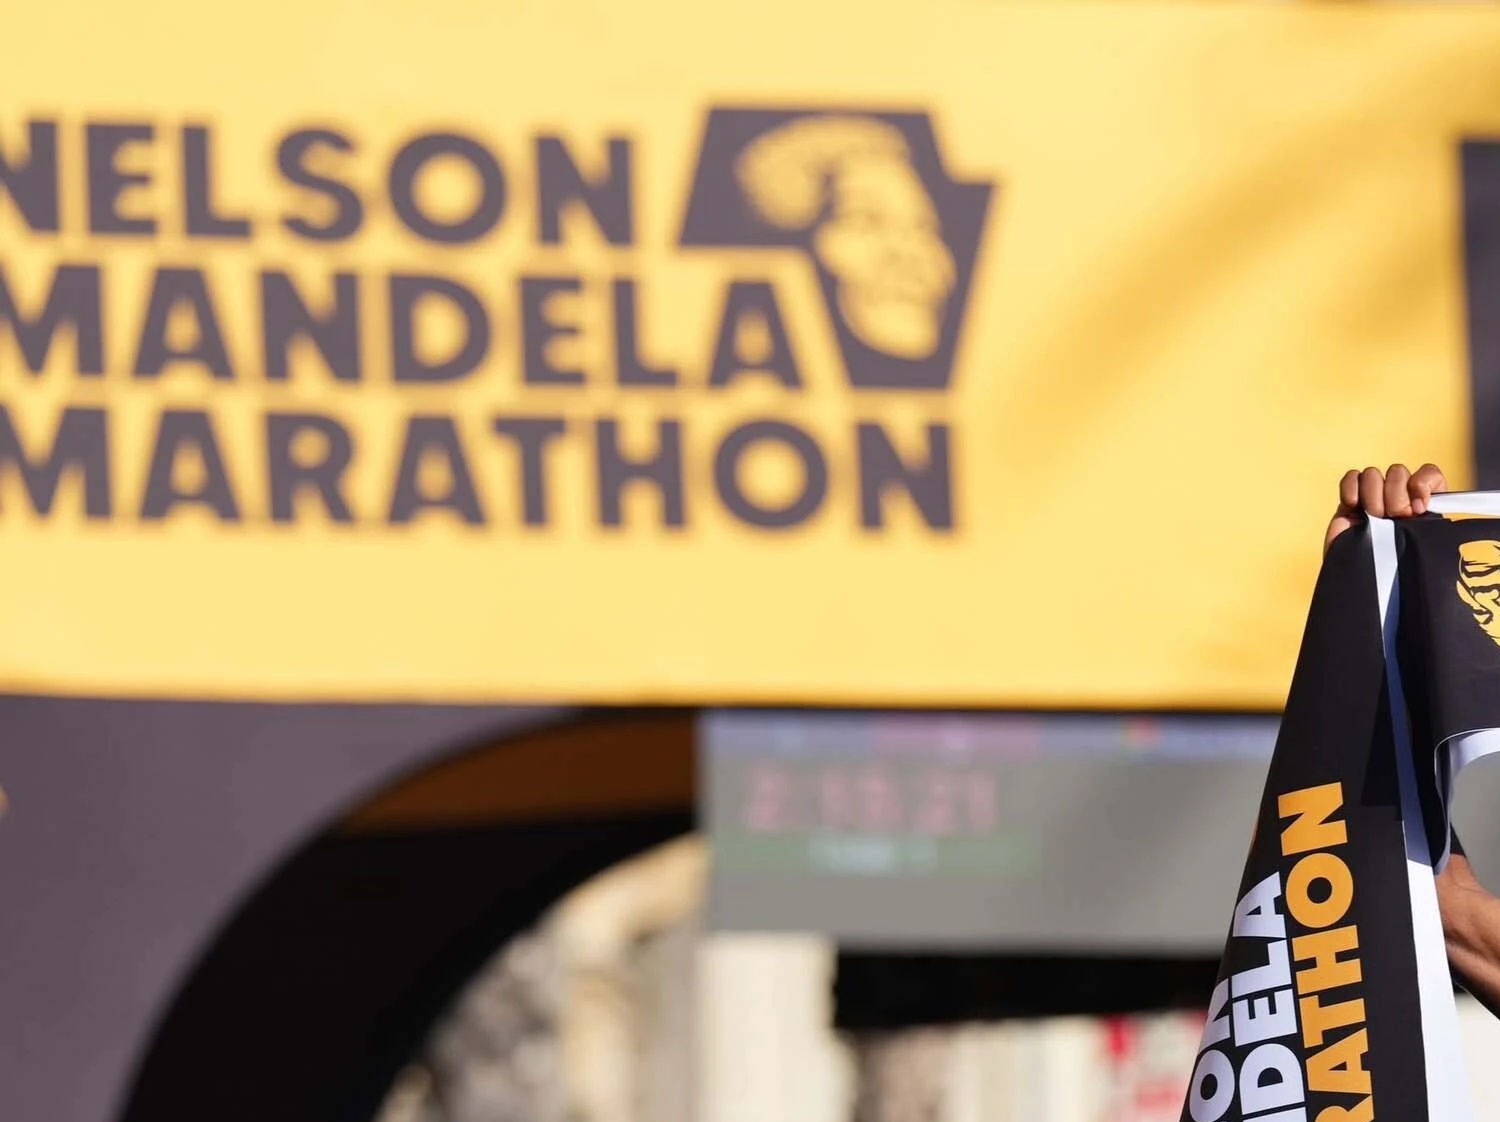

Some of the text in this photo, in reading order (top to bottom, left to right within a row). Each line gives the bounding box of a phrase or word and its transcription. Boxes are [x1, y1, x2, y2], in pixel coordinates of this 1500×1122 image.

[0, 119, 634, 247] NELSON
[0, 262, 805, 391] MANDELA
[0, 405, 957, 532] MARATHON
